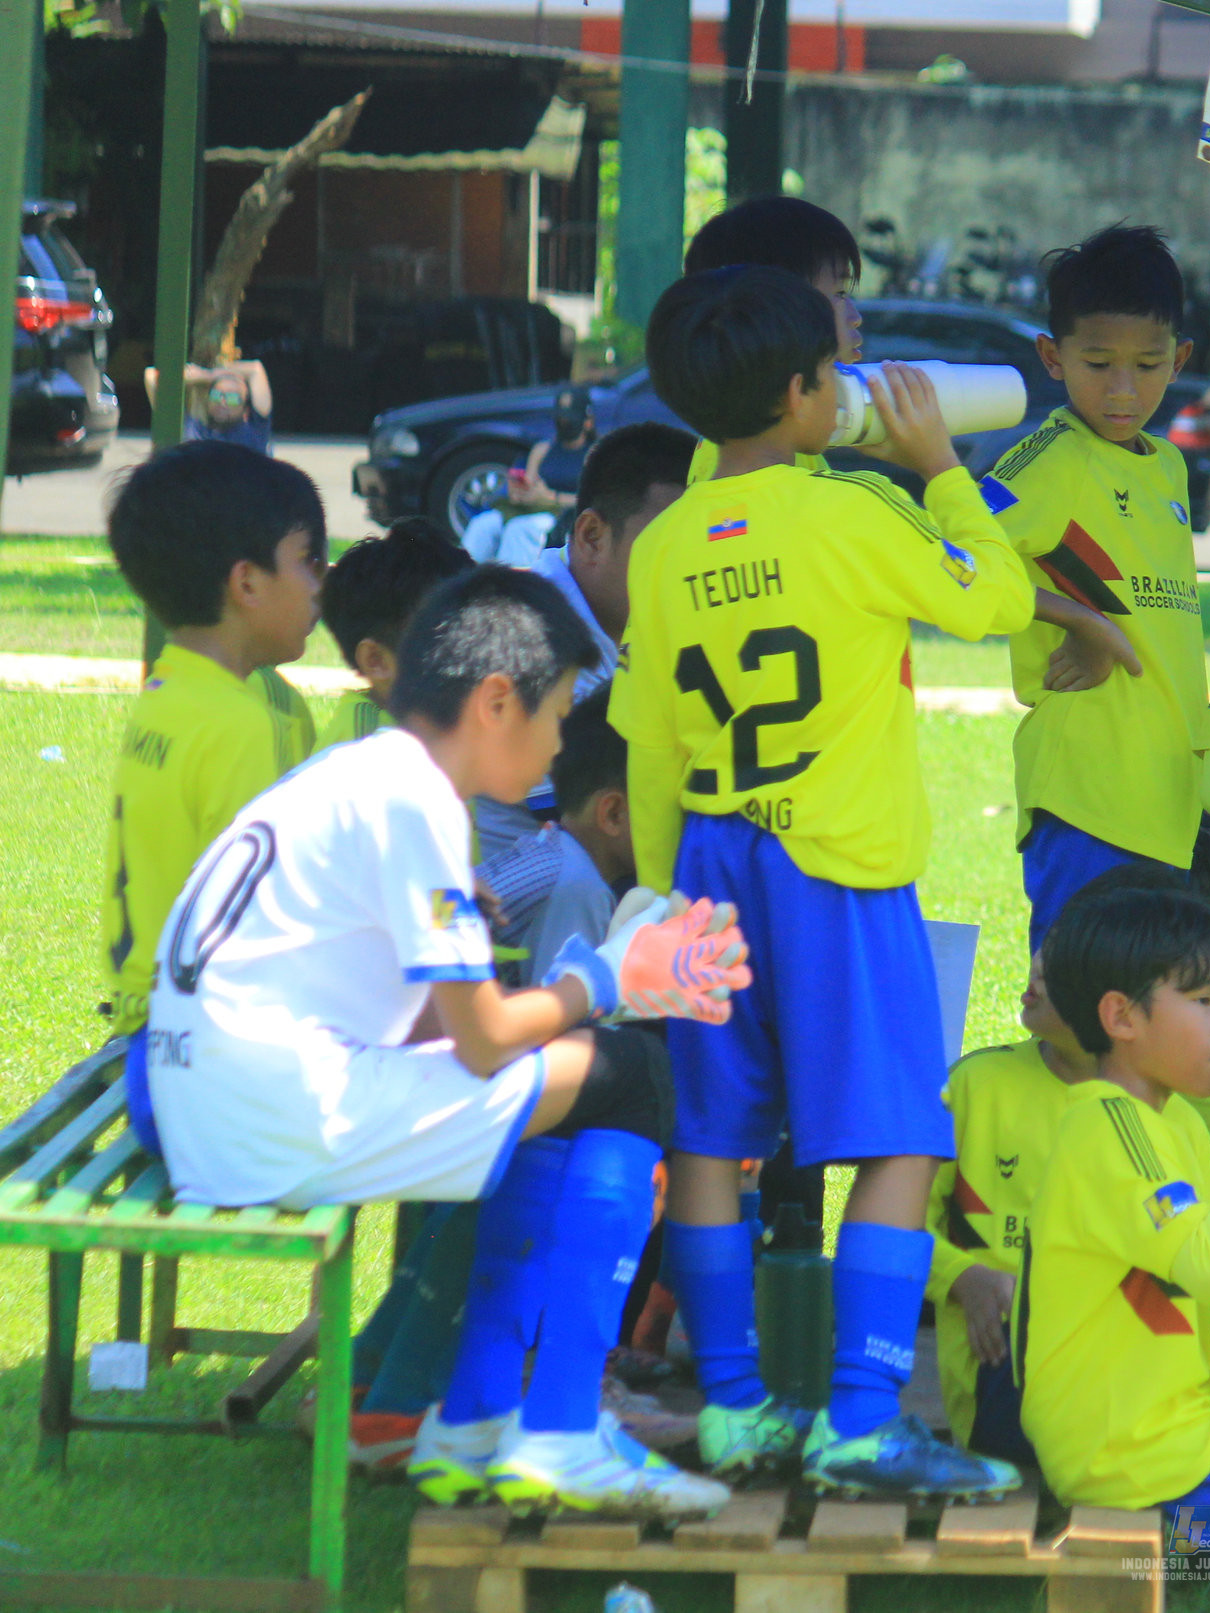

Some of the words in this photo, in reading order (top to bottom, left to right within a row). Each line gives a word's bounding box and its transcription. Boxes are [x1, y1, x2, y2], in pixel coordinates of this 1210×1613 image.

[683, 558, 783, 611] TEDUH
[1131, 575, 1198, 600] BRAZILIAN
[1134, 595, 1174, 609] SOCCER
[674, 625, 822, 795] 12
